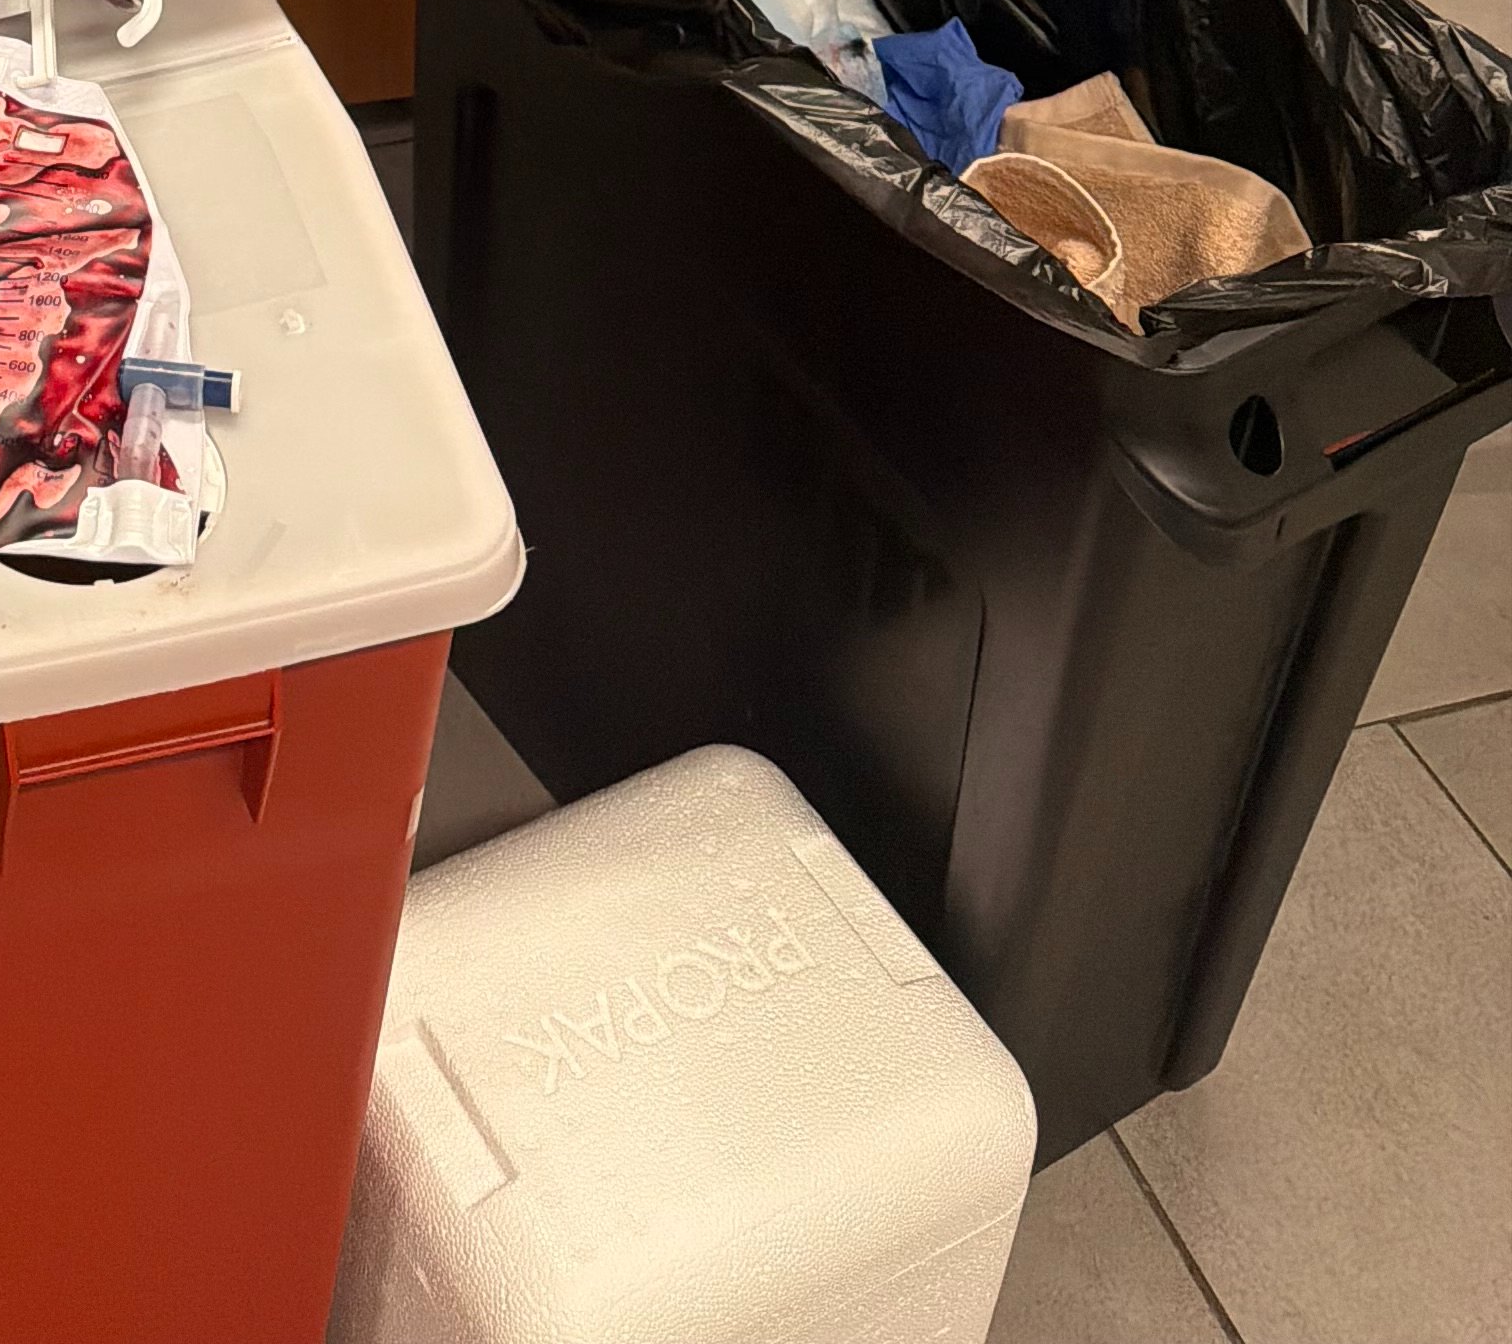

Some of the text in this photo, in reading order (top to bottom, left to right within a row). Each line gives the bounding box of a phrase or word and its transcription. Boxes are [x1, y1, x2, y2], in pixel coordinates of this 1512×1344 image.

[34, 272, 69, 285] 1200
[28, 295, 62, 307] 1000
[18, 330, 45, 343] 800
[8, 361, 36, 374] 600
[503, 906, 817, 1095] PROPAK
